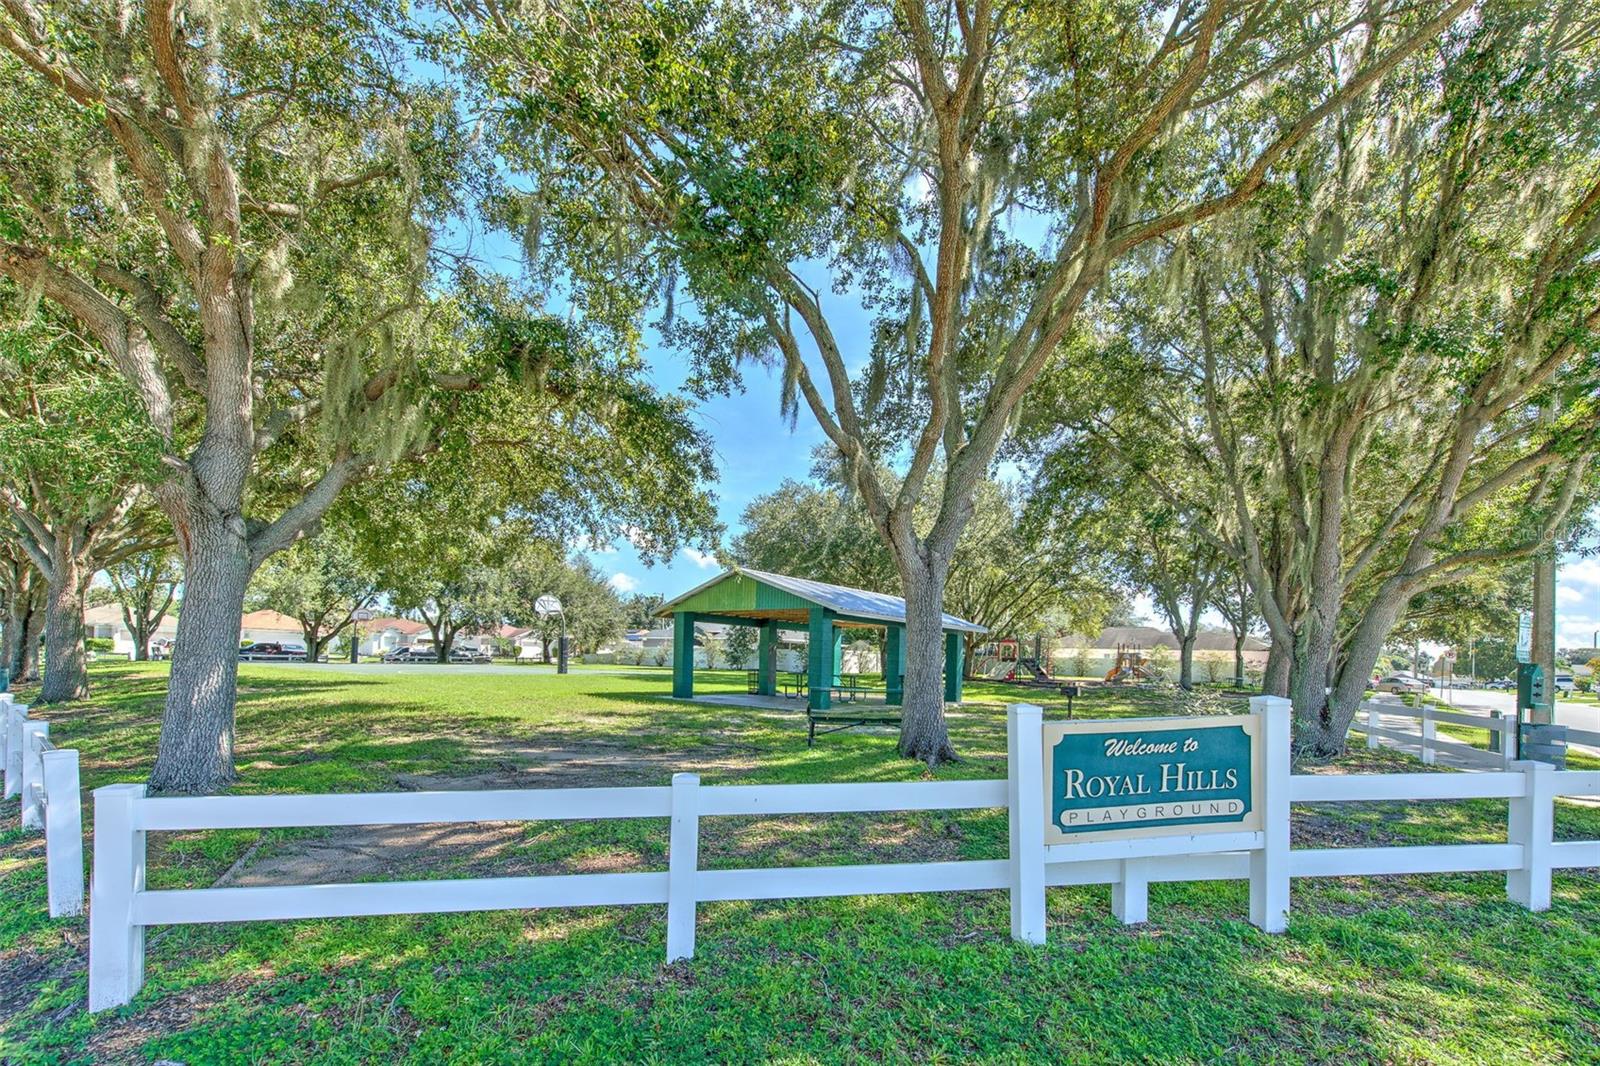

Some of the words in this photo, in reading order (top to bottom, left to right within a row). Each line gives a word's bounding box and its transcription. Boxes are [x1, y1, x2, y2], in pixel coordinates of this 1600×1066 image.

[1104, 737, 1177, 757] Welcome
[1183, 737, 1199, 752] to
[1063, 769, 1151, 800] ROYAL
[1158, 762, 1238, 792] HILLS
[1069, 801, 1239, 824] PLAYGROUND
